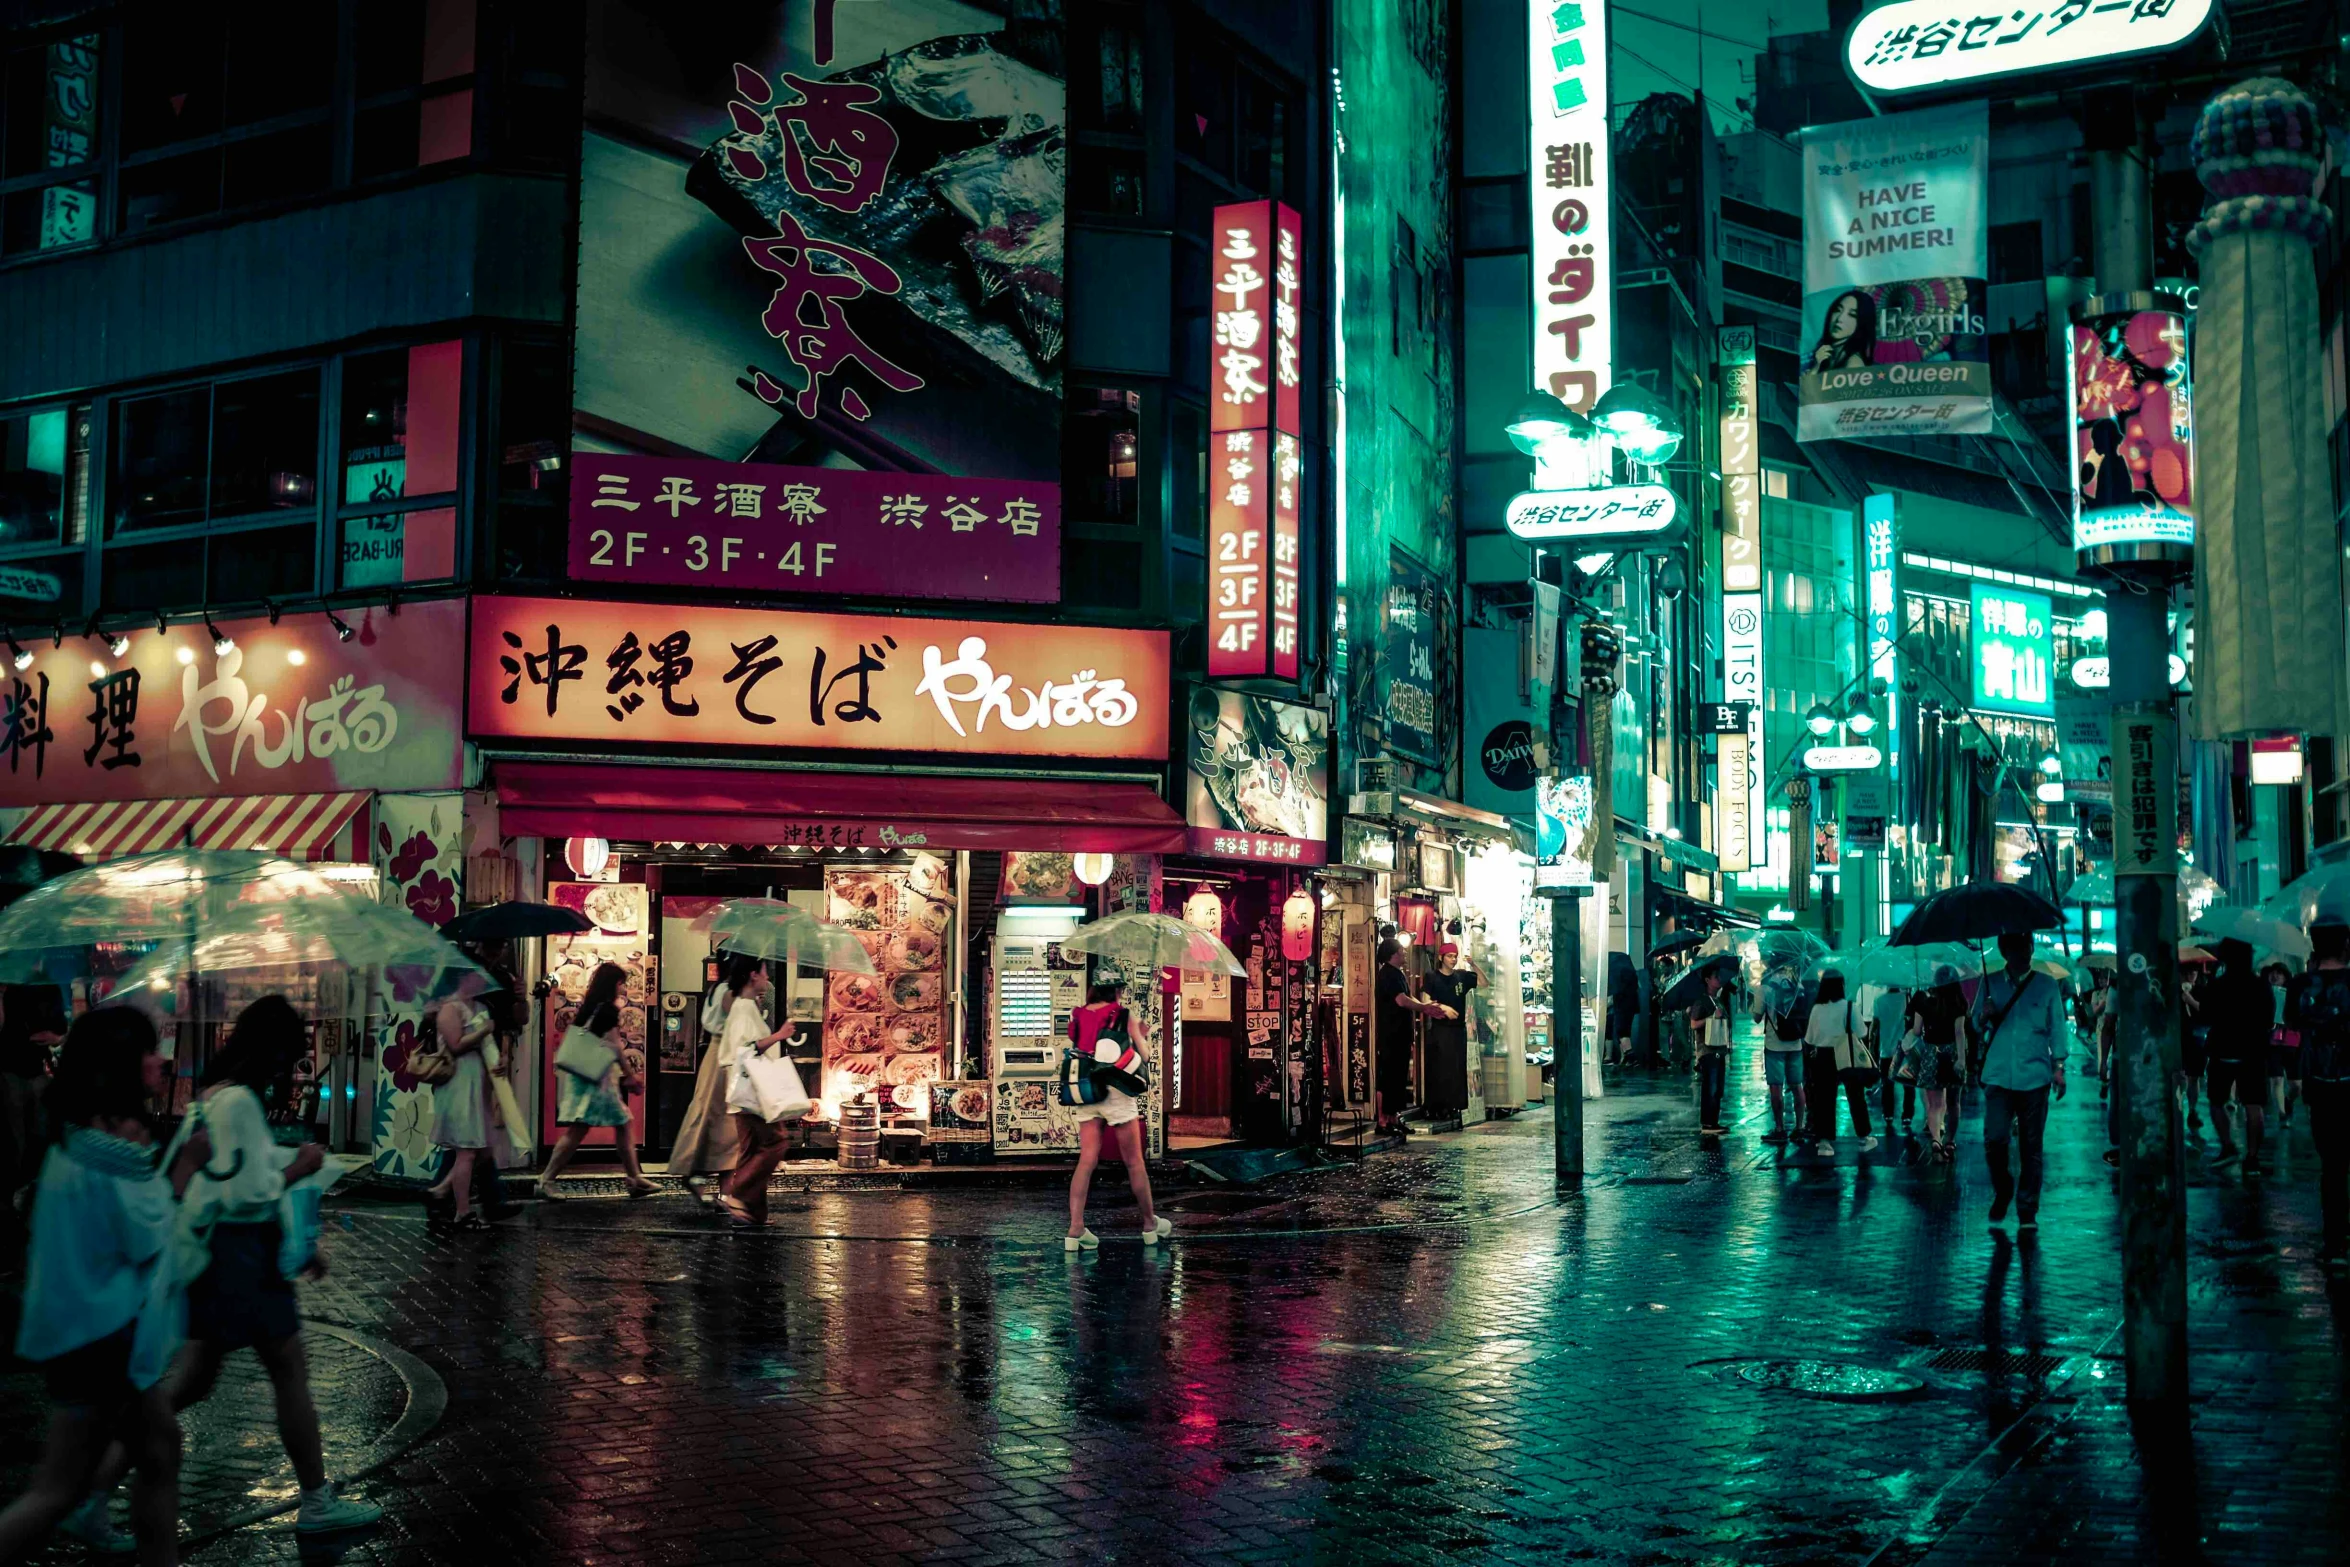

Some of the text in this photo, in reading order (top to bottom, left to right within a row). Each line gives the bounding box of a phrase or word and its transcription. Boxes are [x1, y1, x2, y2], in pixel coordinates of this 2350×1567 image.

[1864, 0, 2176, 66] 渋谷センター街
[1551, 0, 1588, 110] 金問屋
[727, 0, 925, 420] 酒寮
[1859, 182, 1926, 208] HAVE
[1847, 205, 1935, 235] A NICE
[1829, 228, 1954, 259] SUMMER!
[1545, 142, 1597, 414] 靴のダイワ
[1821, 365, 1968, 391] Love Queen
[1836, 403, 1957, 424] 渋谷センター街
[880, 493, 1042, 536] 渋谷店
[1513, 498, 1666, 525] 渋谷センター街
[1219, 531, 1260, 561] 2F
[1275, 533, 1296, 563] 2F
[1219, 577, 1259, 607] 3F
[1275, 579, 1296, 609] 3F
[1218, 624, 1258, 652] 4F
[1275, 626, 1295, 654] 4F
[500, 624, 1138, 737] 沖縄そば やんばる
[1981, 640, 2046, 703] 青山
[0, 647, 398, 784] 料理 やんばる
[1716, 706, 1738, 725] BF
[1732, 645, 1761, 790] ITS'D
[1486, 741, 1534, 766] DAIW
[1731, 750, 1745, 857] BODY FOCUS
[2128, 724, 2158, 864] 客引きは犯罪です
[783, 824, 928, 845] 沖縄そば やんばる
[1247, 1017, 1279, 1029] STOP
[1352, 1015, 1365, 1026] 5F
